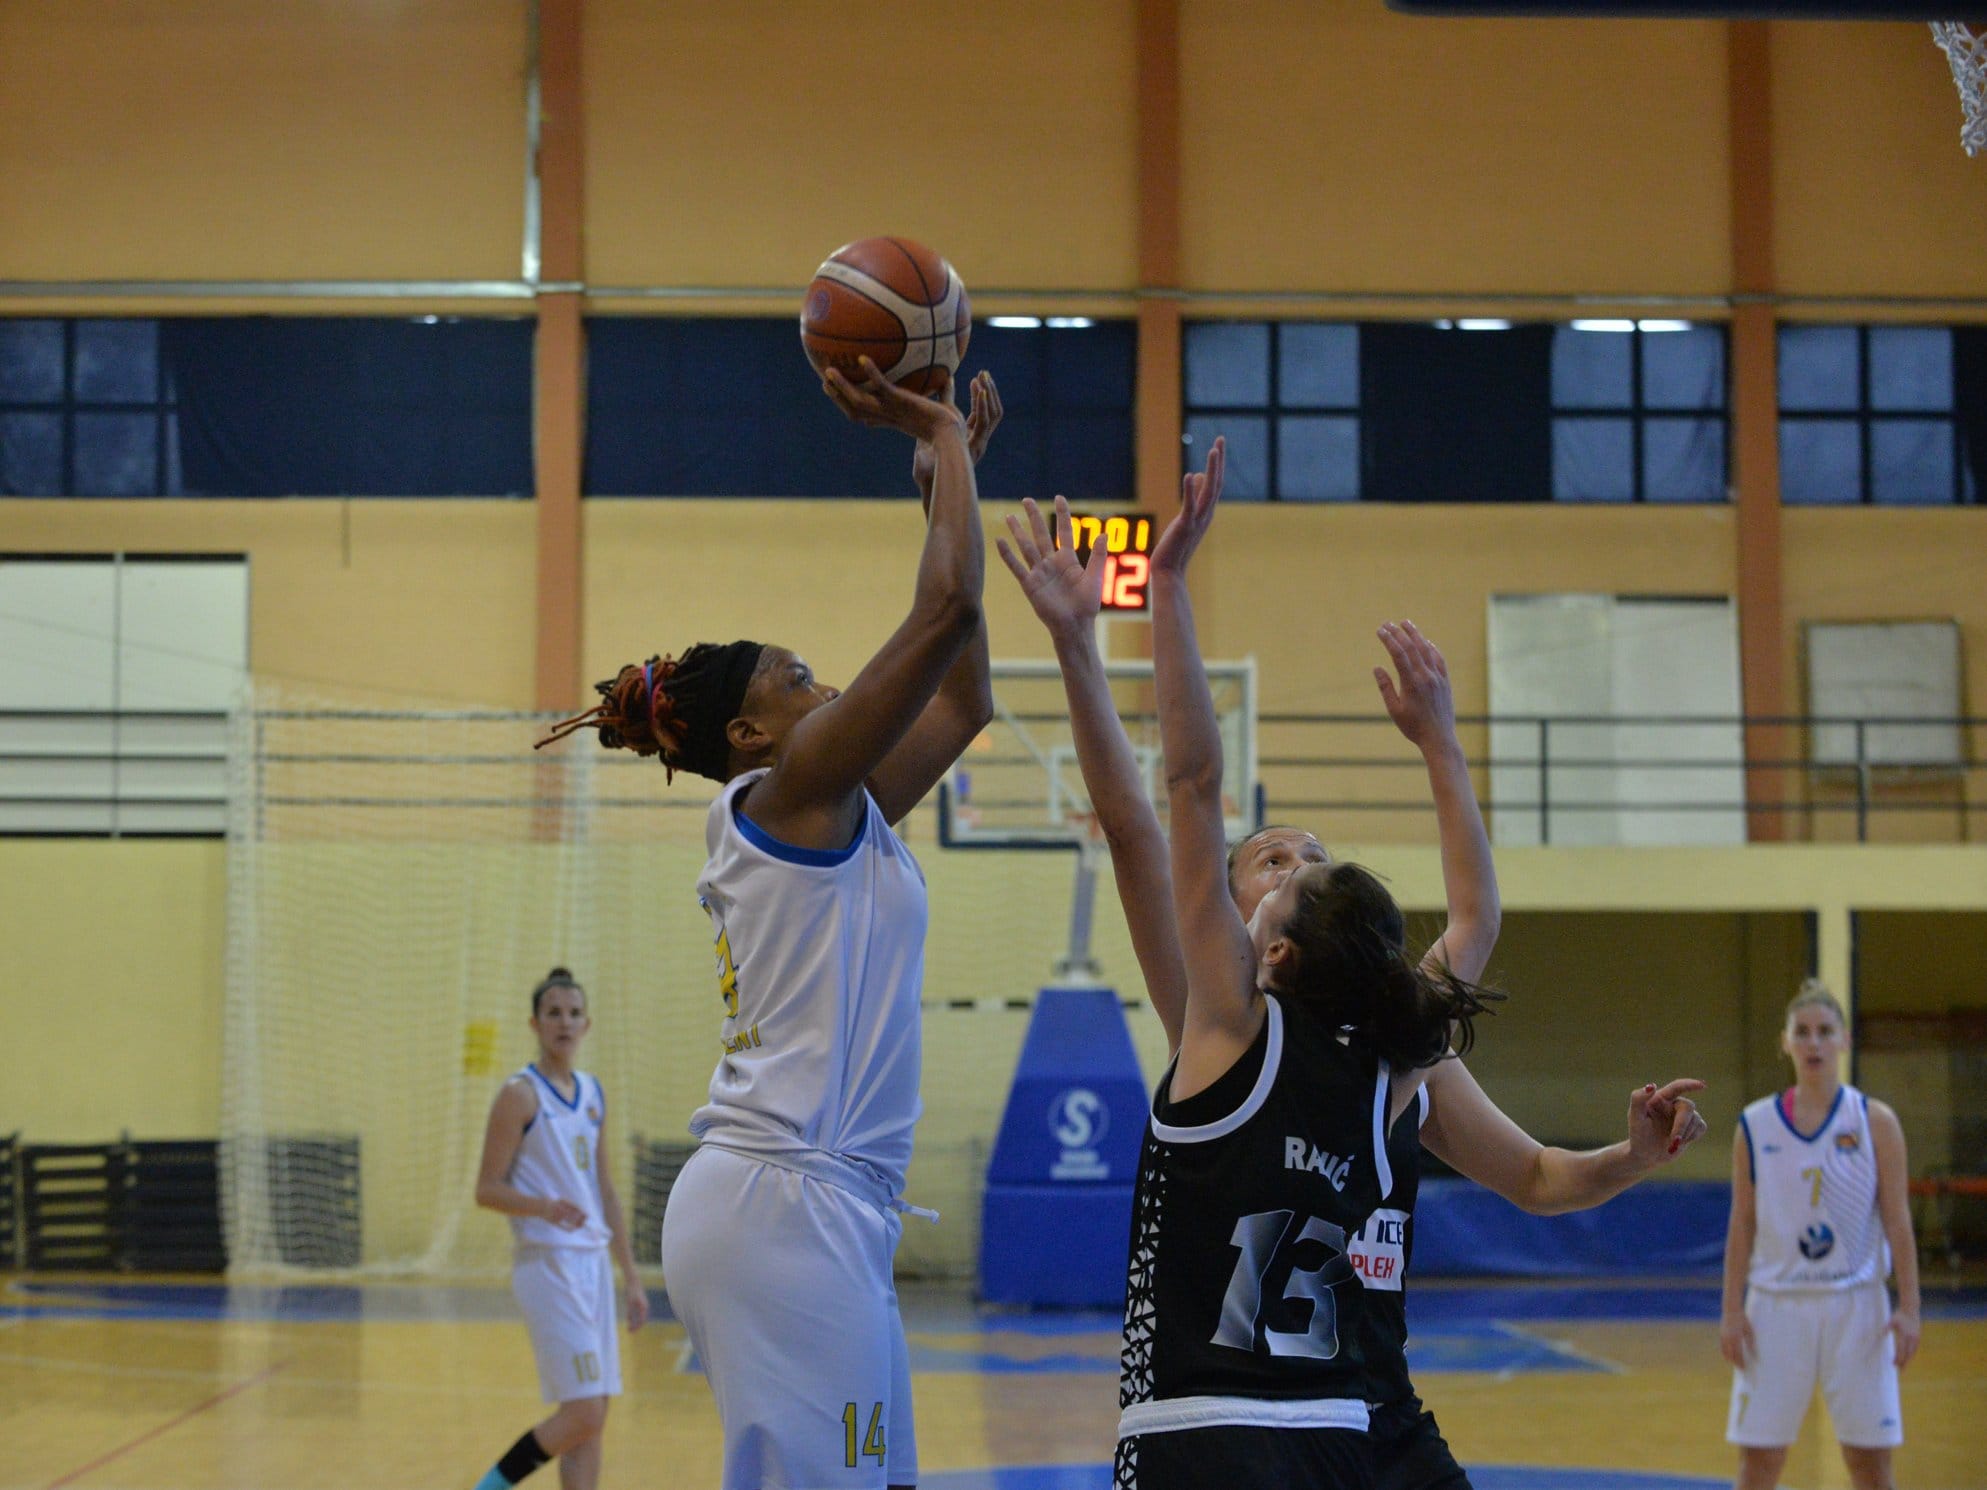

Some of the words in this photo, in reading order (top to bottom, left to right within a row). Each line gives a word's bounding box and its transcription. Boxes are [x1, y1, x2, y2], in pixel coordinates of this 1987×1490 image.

[1101, 554, 1149, 607] 12
[1802, 1167, 1823, 1207] 7
[1209, 1208, 1355, 1360] 13
[572, 1351, 600, 1384] 10
[842, 1401, 886, 1467] 14
